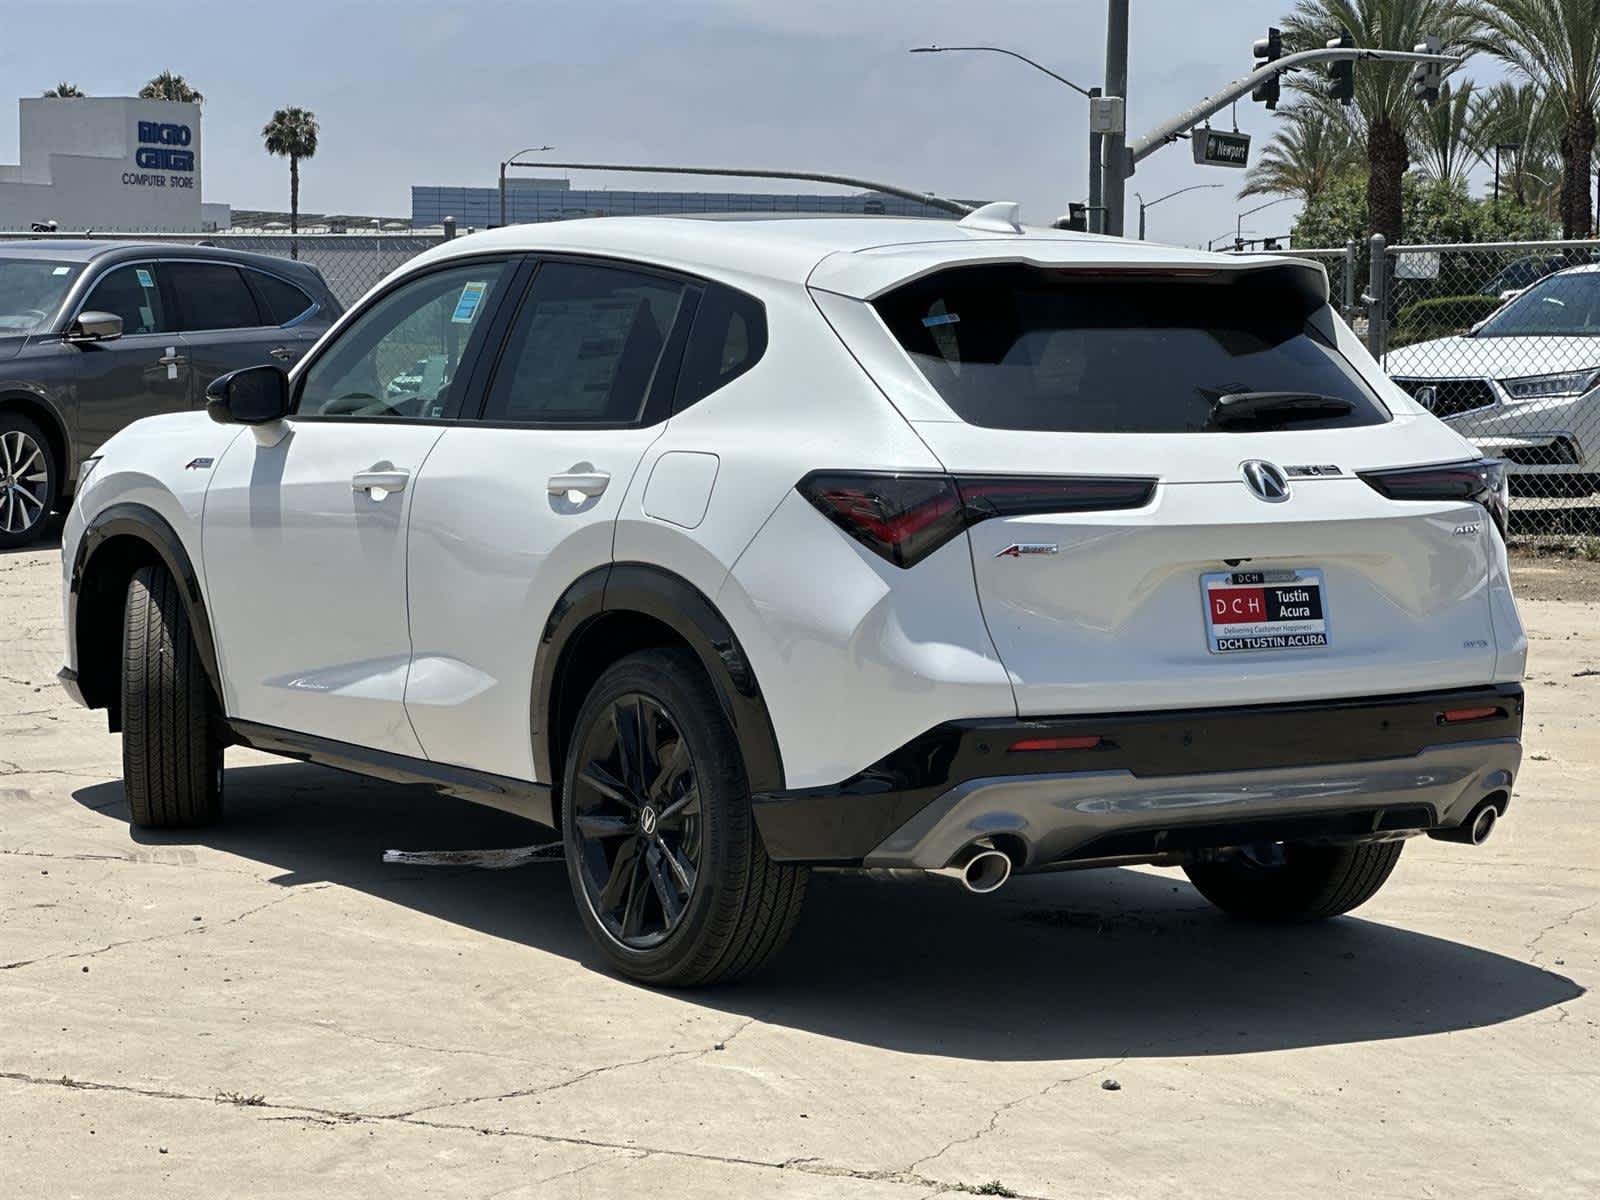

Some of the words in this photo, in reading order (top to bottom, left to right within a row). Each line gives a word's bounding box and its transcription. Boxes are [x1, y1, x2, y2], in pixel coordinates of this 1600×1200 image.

[138, 120, 191, 147] MICRO
[1217, 140, 1245, 160] Newport
[136, 148, 194, 171] CENTER
[122, 173, 166, 187] COMPUTER
[170, 175, 194, 189] STORE
[1238, 574, 1258, 582] DCH
[1276, 590, 1309, 603] Tustin
[1280, 606, 1310, 617] Acura
[1224, 626, 1253, 635] Delivering
[1255, 625, 1280, 633] Customer
[1282, 624, 1312, 633] Happiness
[1219, 639, 1243, 650] DCH
[1246, 637, 1286, 649] TUSTIN
[1288, 634, 1326, 646] ACURA
